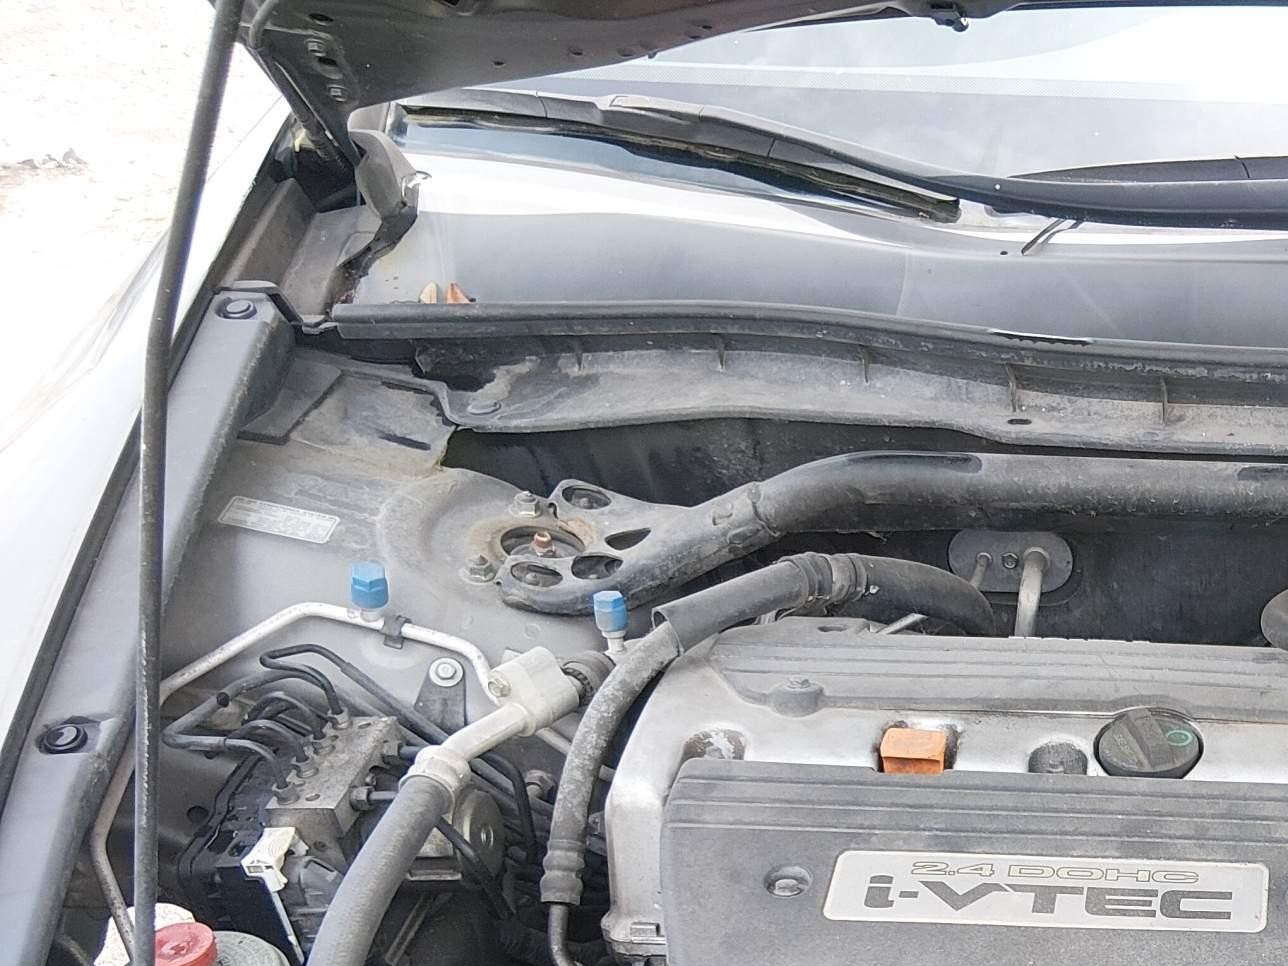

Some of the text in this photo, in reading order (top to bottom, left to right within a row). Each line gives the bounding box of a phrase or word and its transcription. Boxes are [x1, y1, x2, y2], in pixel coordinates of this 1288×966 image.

[910, 861, 1200, 884] 2.4 DOHC
[863, 874, 1233, 920] i-VTEC
